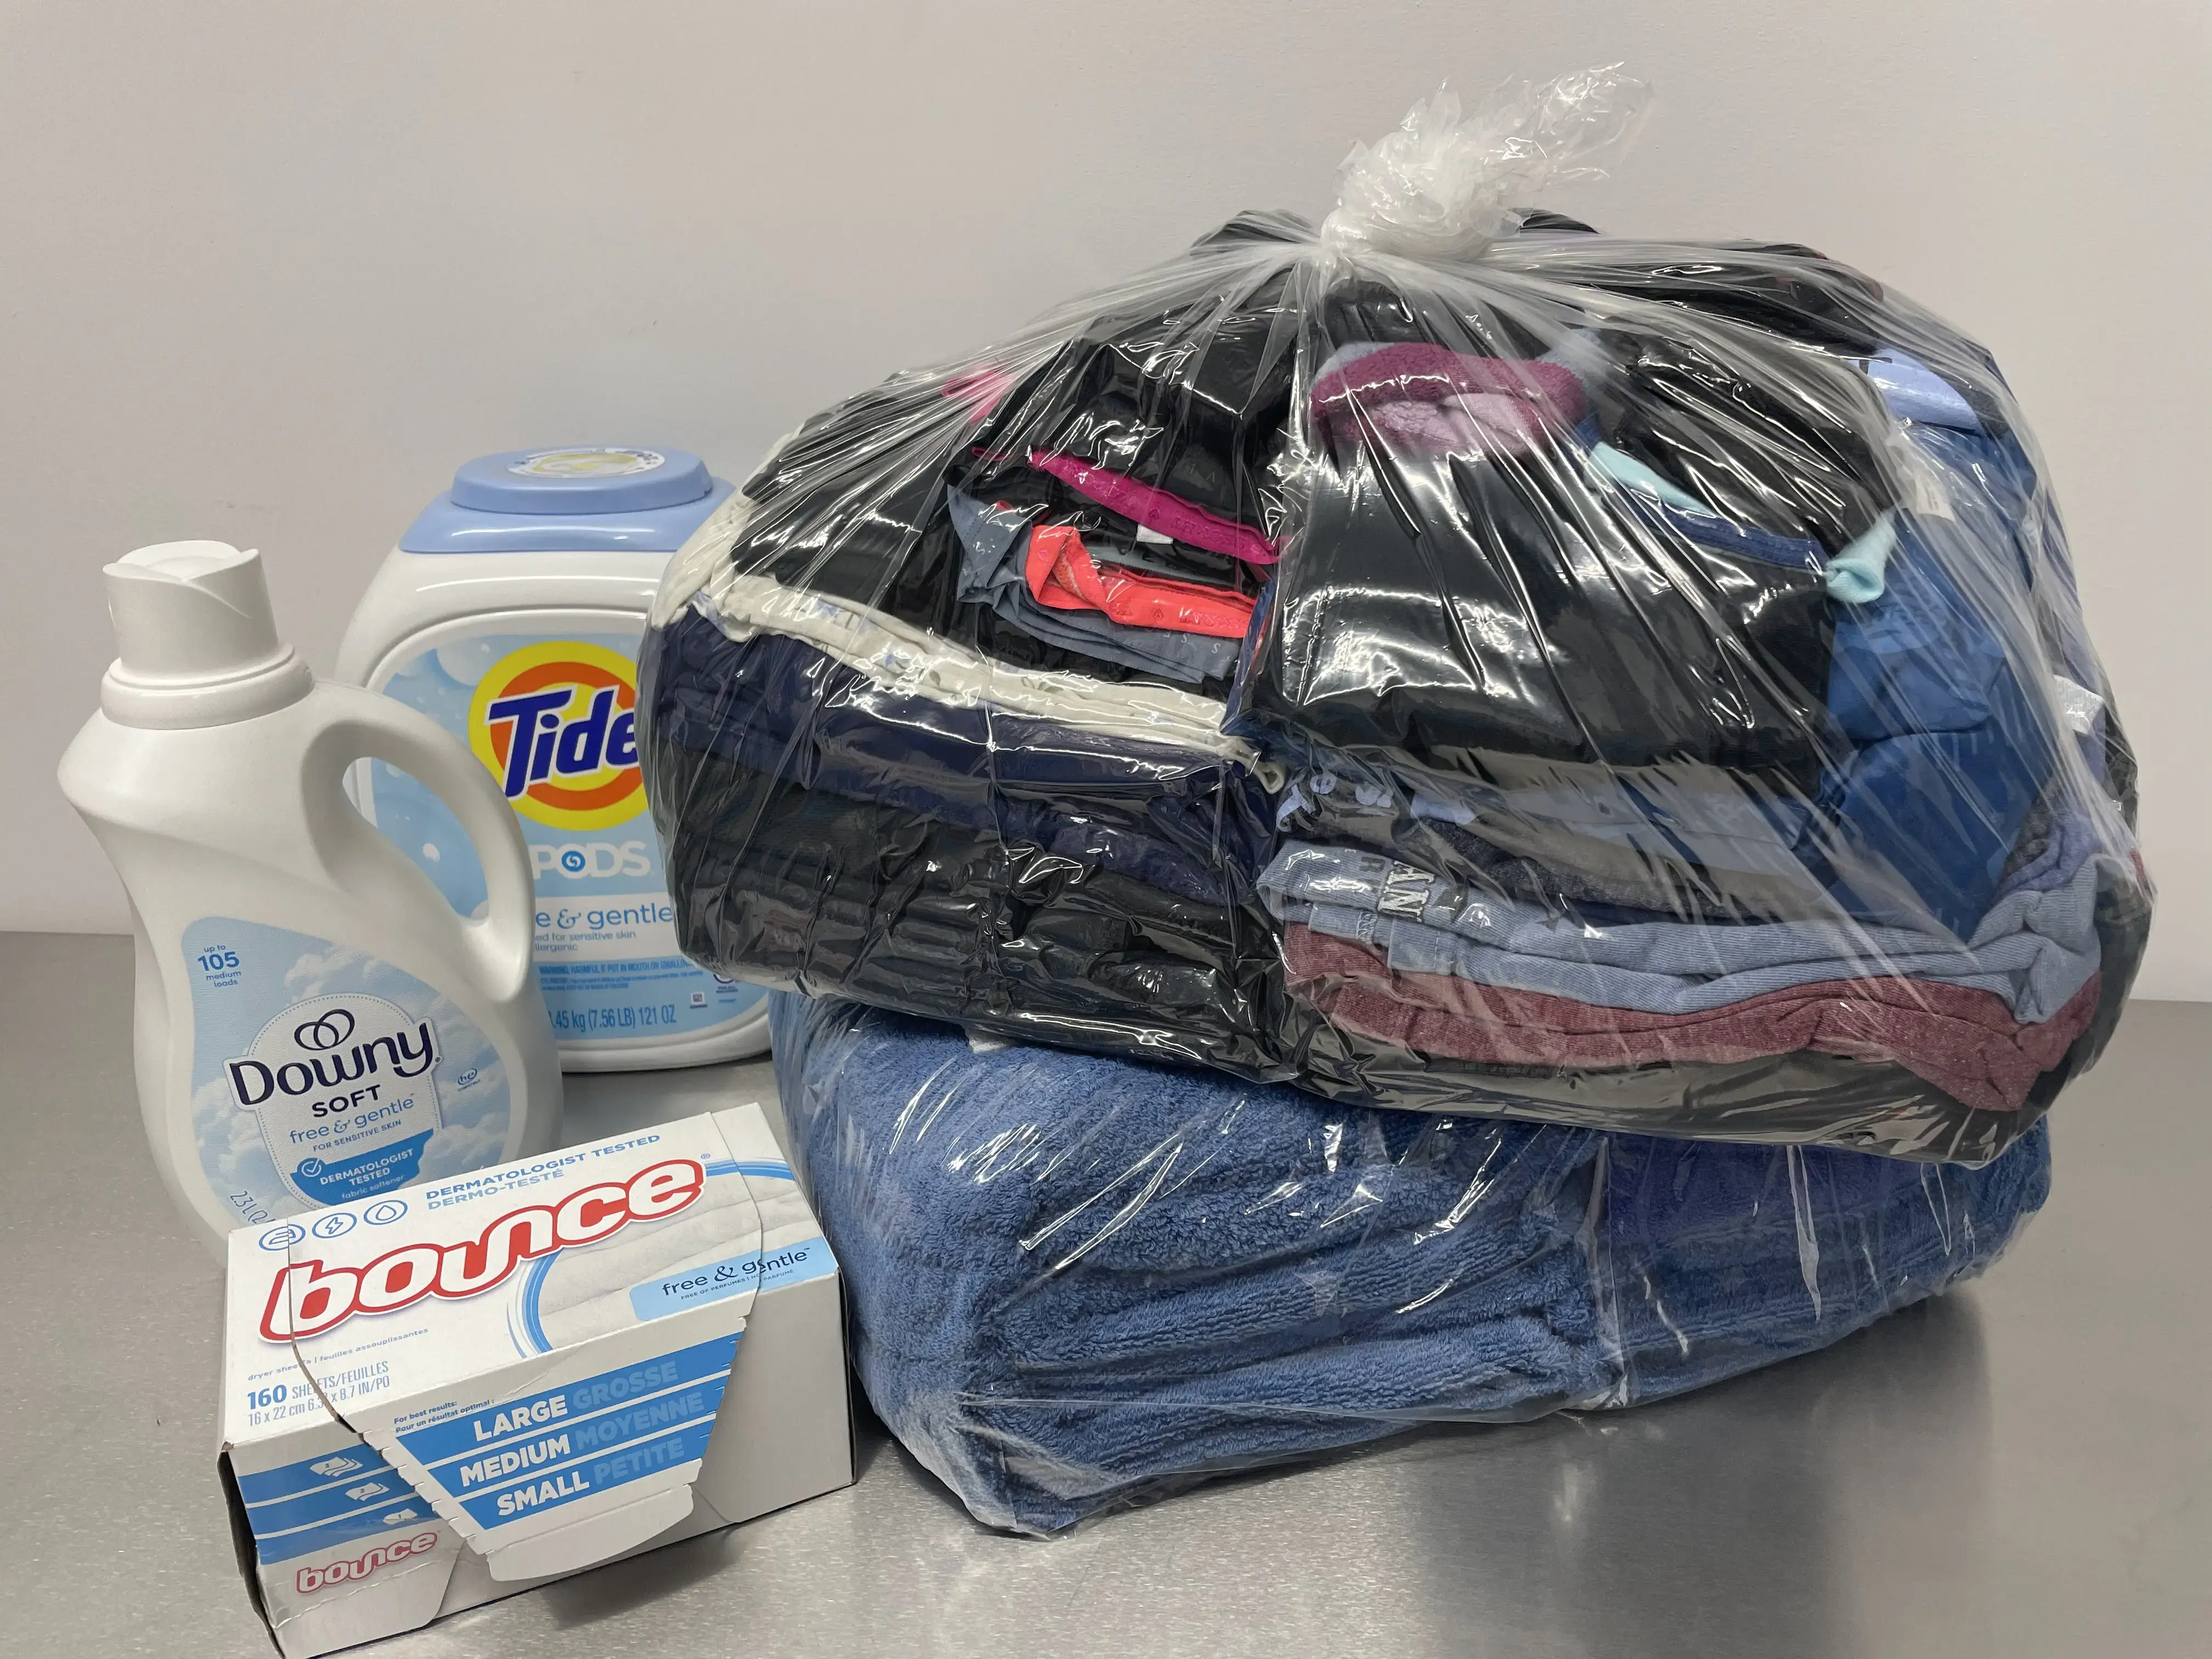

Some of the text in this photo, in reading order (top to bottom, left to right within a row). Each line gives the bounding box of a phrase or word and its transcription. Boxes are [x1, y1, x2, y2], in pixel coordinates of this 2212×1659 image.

[483, 684, 640, 802] Tide
[528, 840, 651, 879] PODS
[557, 909, 582, 929] &
[587, 902, 673, 930] gentle
[569, 931, 613, 941] sensitive
[616, 930, 636, 939] skin
[198, 951, 240, 971] 105
[206, 970, 241, 981] medium
[213, 978, 238, 988] loads
[571, 1010, 585, 1032] kg
[588, 1007, 616, 1031] (7.56
[617, 1005, 635, 1029] LB)
[638, 1005, 658, 1025] 121
[661, 1004, 676, 1024] OZ
[229, 1023, 433, 1105] Downy
[312, 1084, 381, 1118] SOFT
[290, 1098, 414, 1144] free & gentle
[313, 1119, 402, 1152] FOR SENSITIVE SKIN
[320, 1148, 414, 1186] DERMATOLOGIST
[348, 1168, 391, 1187] TESTED
[426, 1134, 660, 1199] DERMATOLOGIST TESTED
[341, 1187, 368, 1200] fabric
[428, 1168, 564, 1210] DERMO-TESTÉ
[259, 1158, 707, 1342] bounce
[662, 1251, 808, 1296] free & gentle
[681, 1291, 698, 1300] FREE
[711, 1278, 746, 1291] PERFUMES
[247, 1370, 273, 1381] dryer
[320, 1348, 353, 1362] feuilles
[355, 1328, 428, 1352] assouplissantes
[247, 1384, 287, 1410] 160
[248, 1412, 262, 1426] 16
[264, 1413, 270, 1423] x
[273, 1404, 286, 1420] 22
[289, 1403, 306, 1416] cm
[331, 1393, 337, 1403] x
[340, 1383, 355, 1400] 8.7
[358, 1375, 390, 1396] IN/PO
[394, 1401, 458, 1424] For best results:
[428, 1409, 458, 1424] résultat
[460, 1400, 490, 1414] optimal
[474, 1361, 678, 1442] LARGE GROSSE
[460, 1392, 704, 1487] MEDIUM MOYENNE
[496, 1437, 684, 1516] SMALL PETITE
[296, 1532, 438, 1594] bounce
